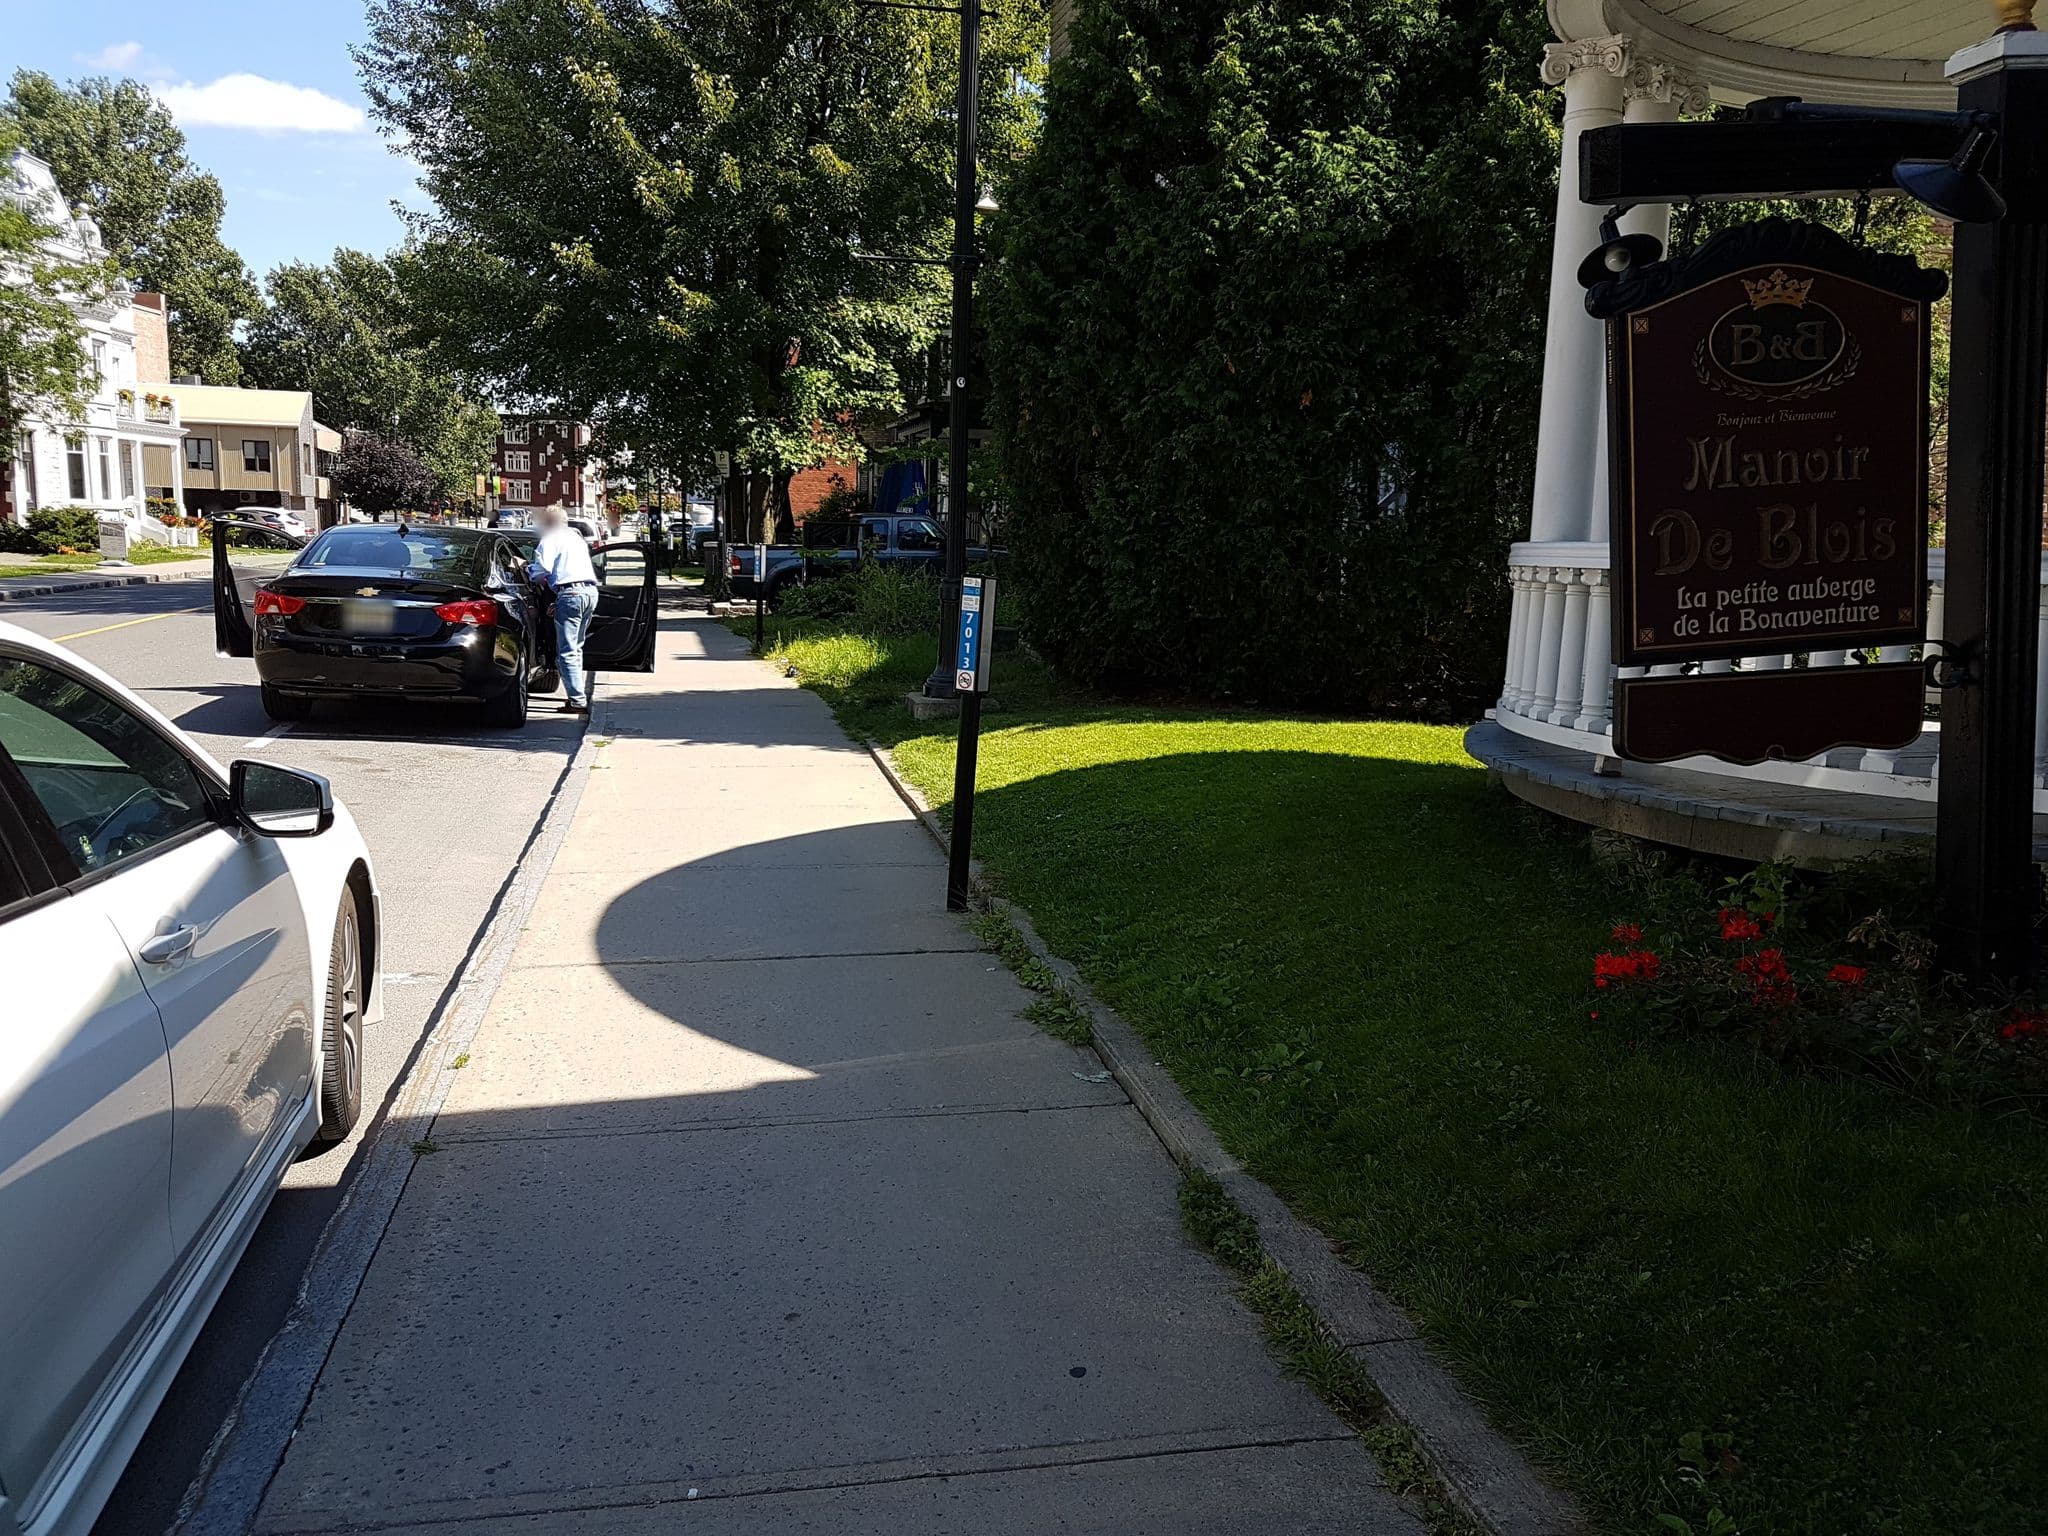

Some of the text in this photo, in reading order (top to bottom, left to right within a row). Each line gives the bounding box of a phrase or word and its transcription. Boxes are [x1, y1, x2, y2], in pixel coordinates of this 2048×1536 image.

[1777, 408, 1837, 423] Bienvenue
[1681, 433, 1871, 491] Manoir
[1649, 502, 1898, 576] De Blois
[1676, 575, 1877, 611] La petite auberge
[1673, 602, 1881, 637] de la Bonaventure
